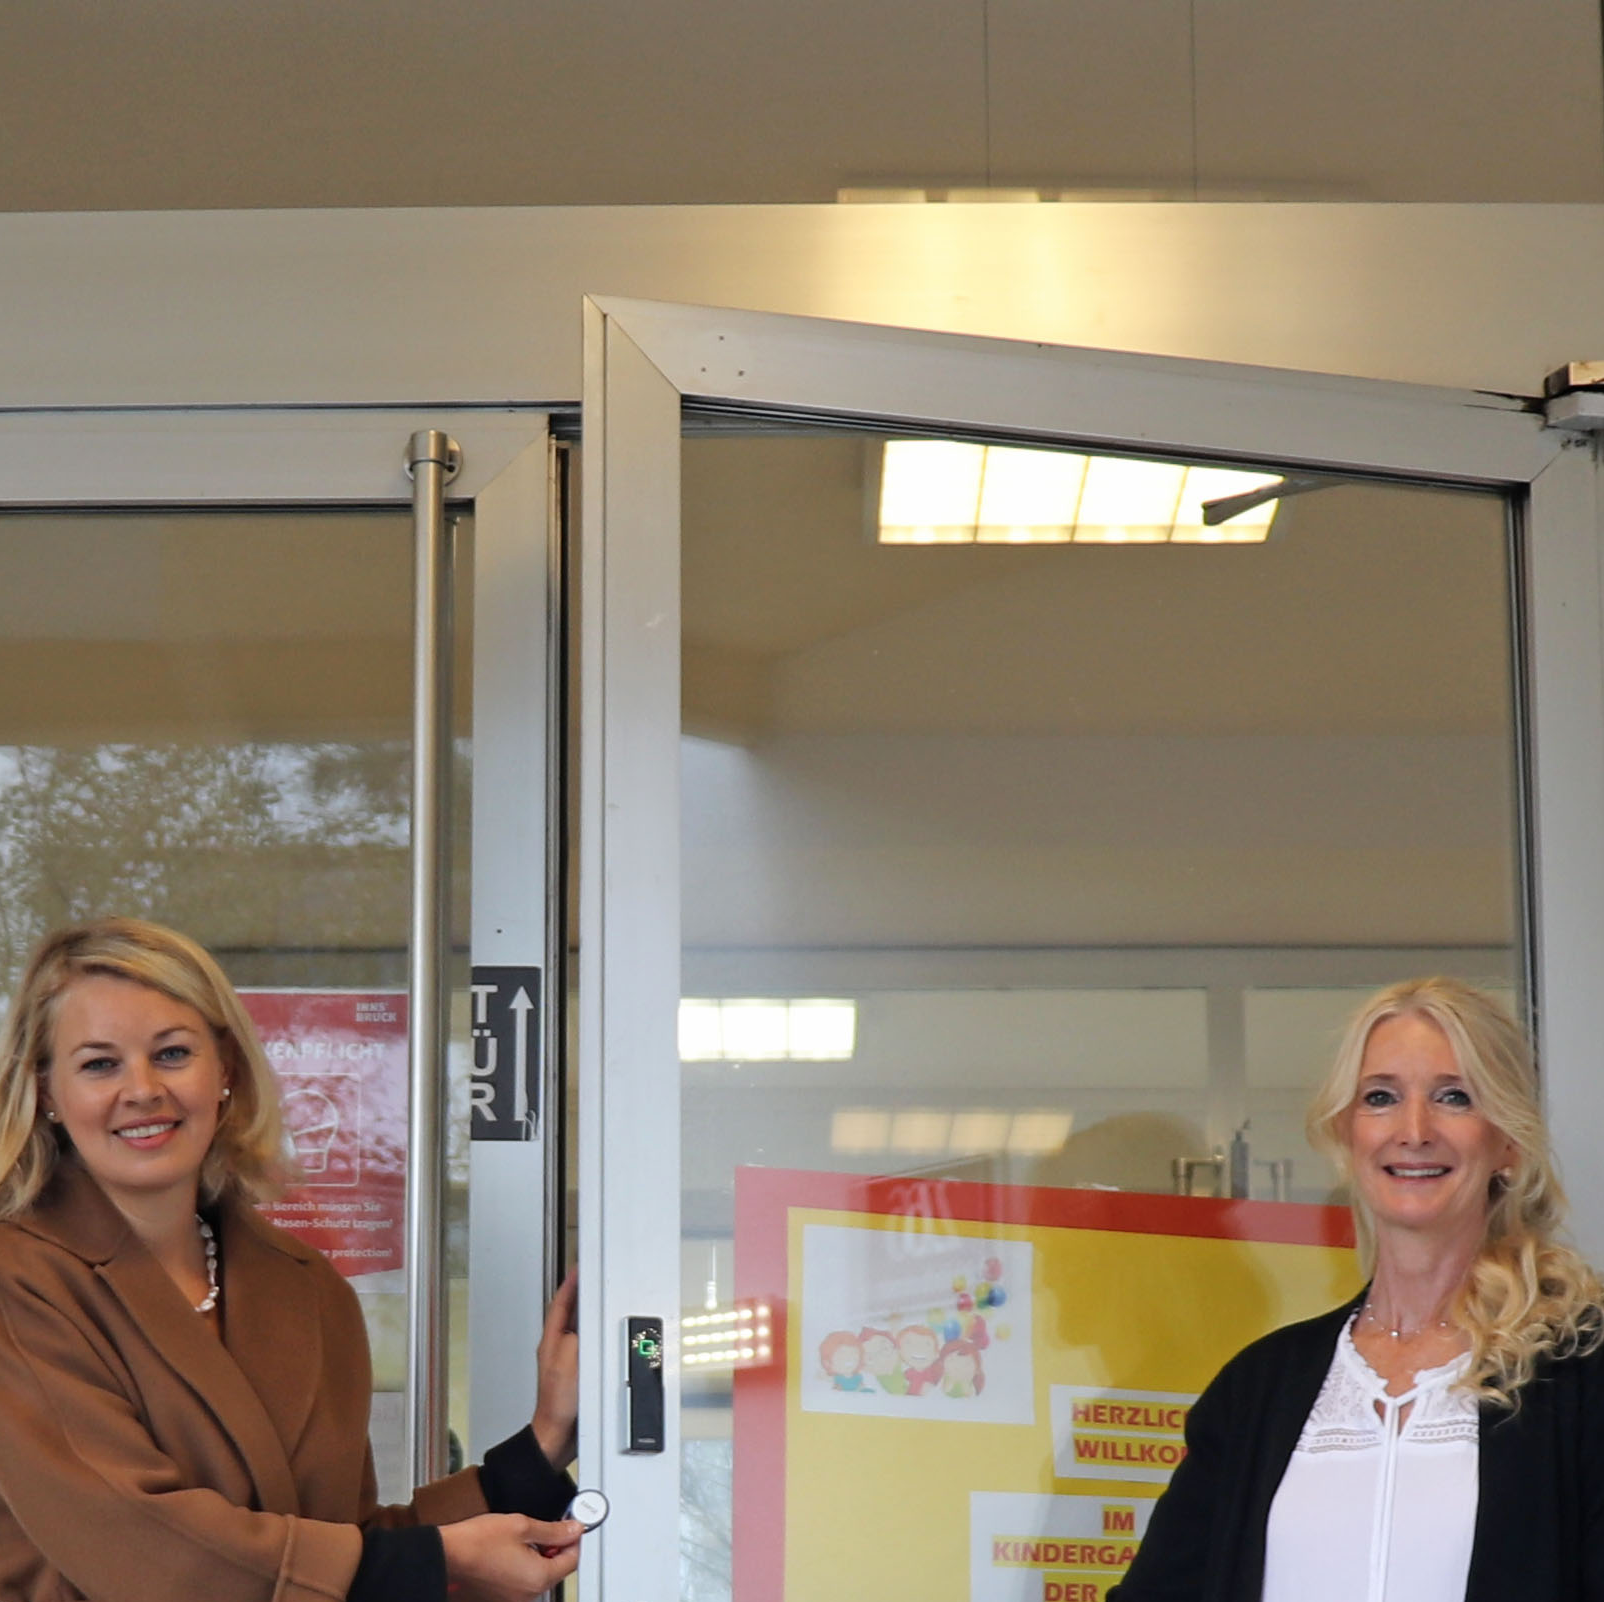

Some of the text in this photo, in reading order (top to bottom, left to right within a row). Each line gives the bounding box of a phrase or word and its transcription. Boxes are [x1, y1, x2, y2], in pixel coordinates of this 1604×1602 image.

[355, 1012, 396, 1022] BRUCK
[273, 1201, 316, 1212] Bereich
[353, 1218, 393, 1231] tragen!
[332, 1247, 393, 1259] protection!
[1072, 1403, 1188, 1428] HERZLIC
[1103, 1511, 1134, 1531] IM
[993, 1541, 1136, 1565] KINDERGA
[1044, 1582, 1097, 1602] DER
